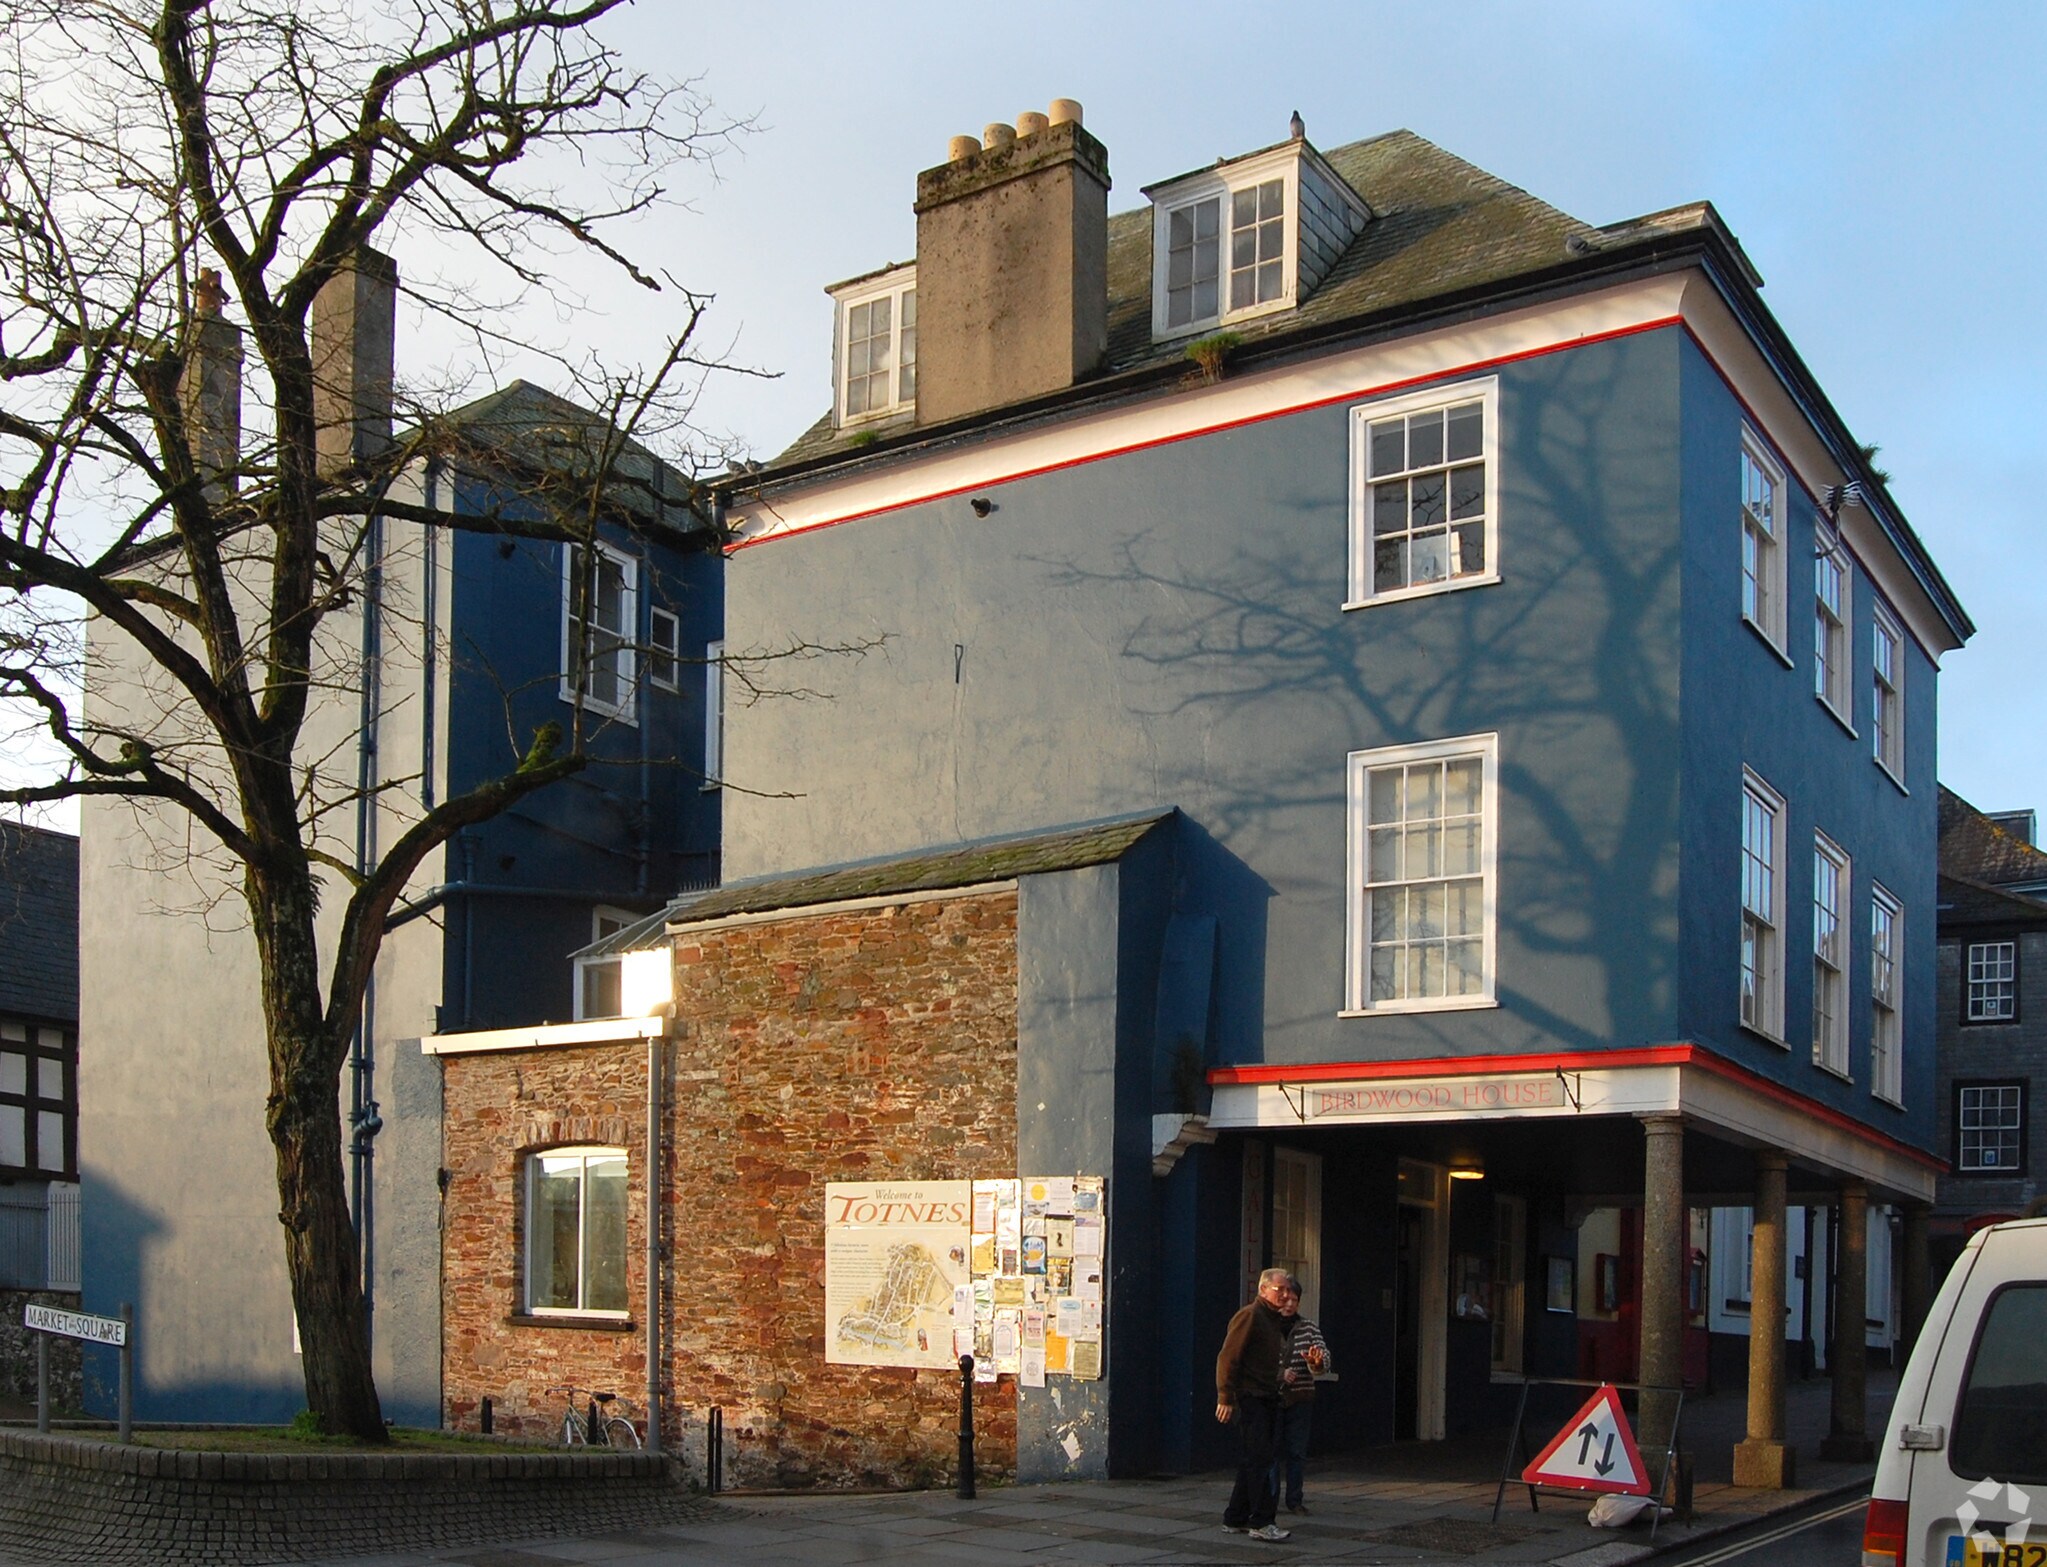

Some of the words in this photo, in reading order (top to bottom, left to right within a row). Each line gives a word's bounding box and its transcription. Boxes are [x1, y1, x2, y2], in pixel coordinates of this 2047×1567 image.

[1321, 1086, 1452, 1112] BIRDWOOD
[1463, 1082, 1553, 1106] HOUSE
[831, 1195, 966, 1223] TOTNES
[875, 1189, 912, 1200] Welcome
[914, 1190, 924, 1200] to
[28, 1308, 70, 1332] MARKET
[76, 1317, 122, 1342] SQUARE
